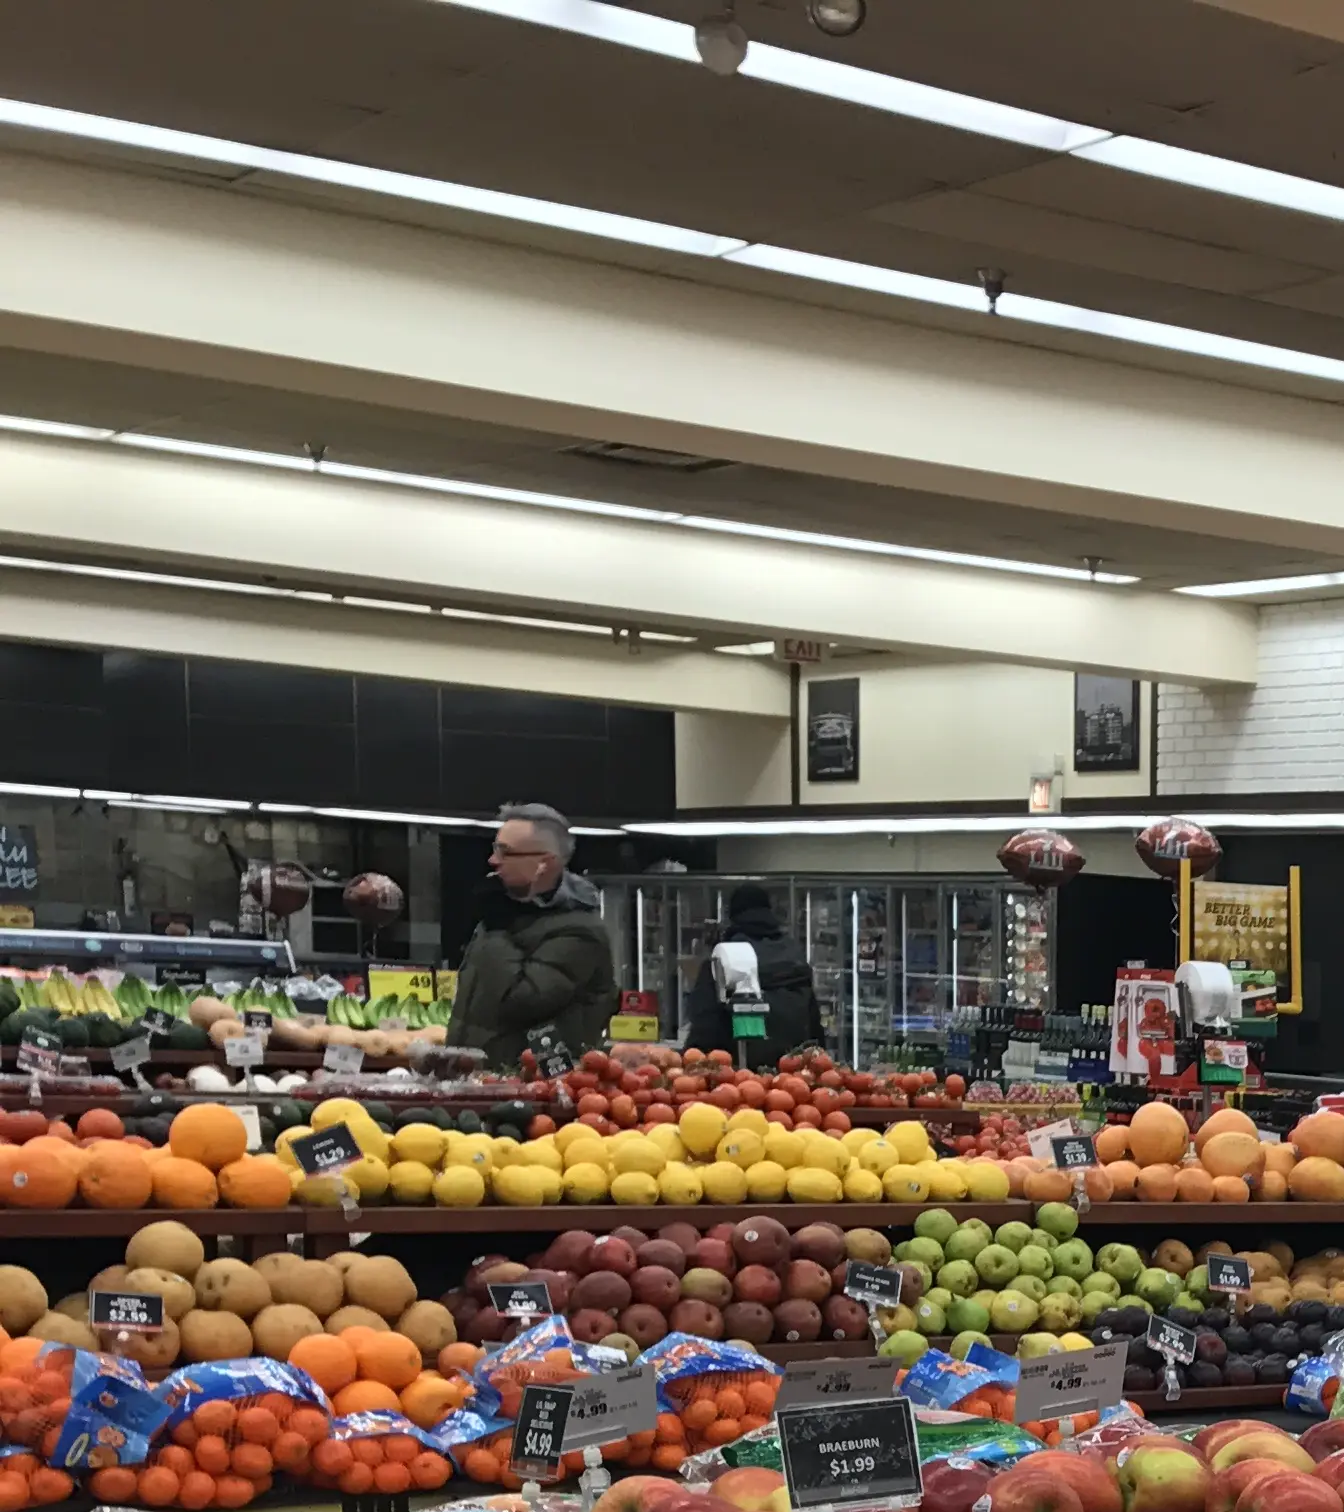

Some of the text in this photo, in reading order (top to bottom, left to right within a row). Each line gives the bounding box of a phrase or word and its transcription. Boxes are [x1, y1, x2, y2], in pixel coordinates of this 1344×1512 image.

[1204, 902, 1250, 915] BETTER
[1215, 915, 1276, 928] BIG GAME
[524, 1429, 553, 1457] $4.99
[819, 1437, 880, 1454] BRAEBURN
[830, 1456, 875, 1477] $1.99
